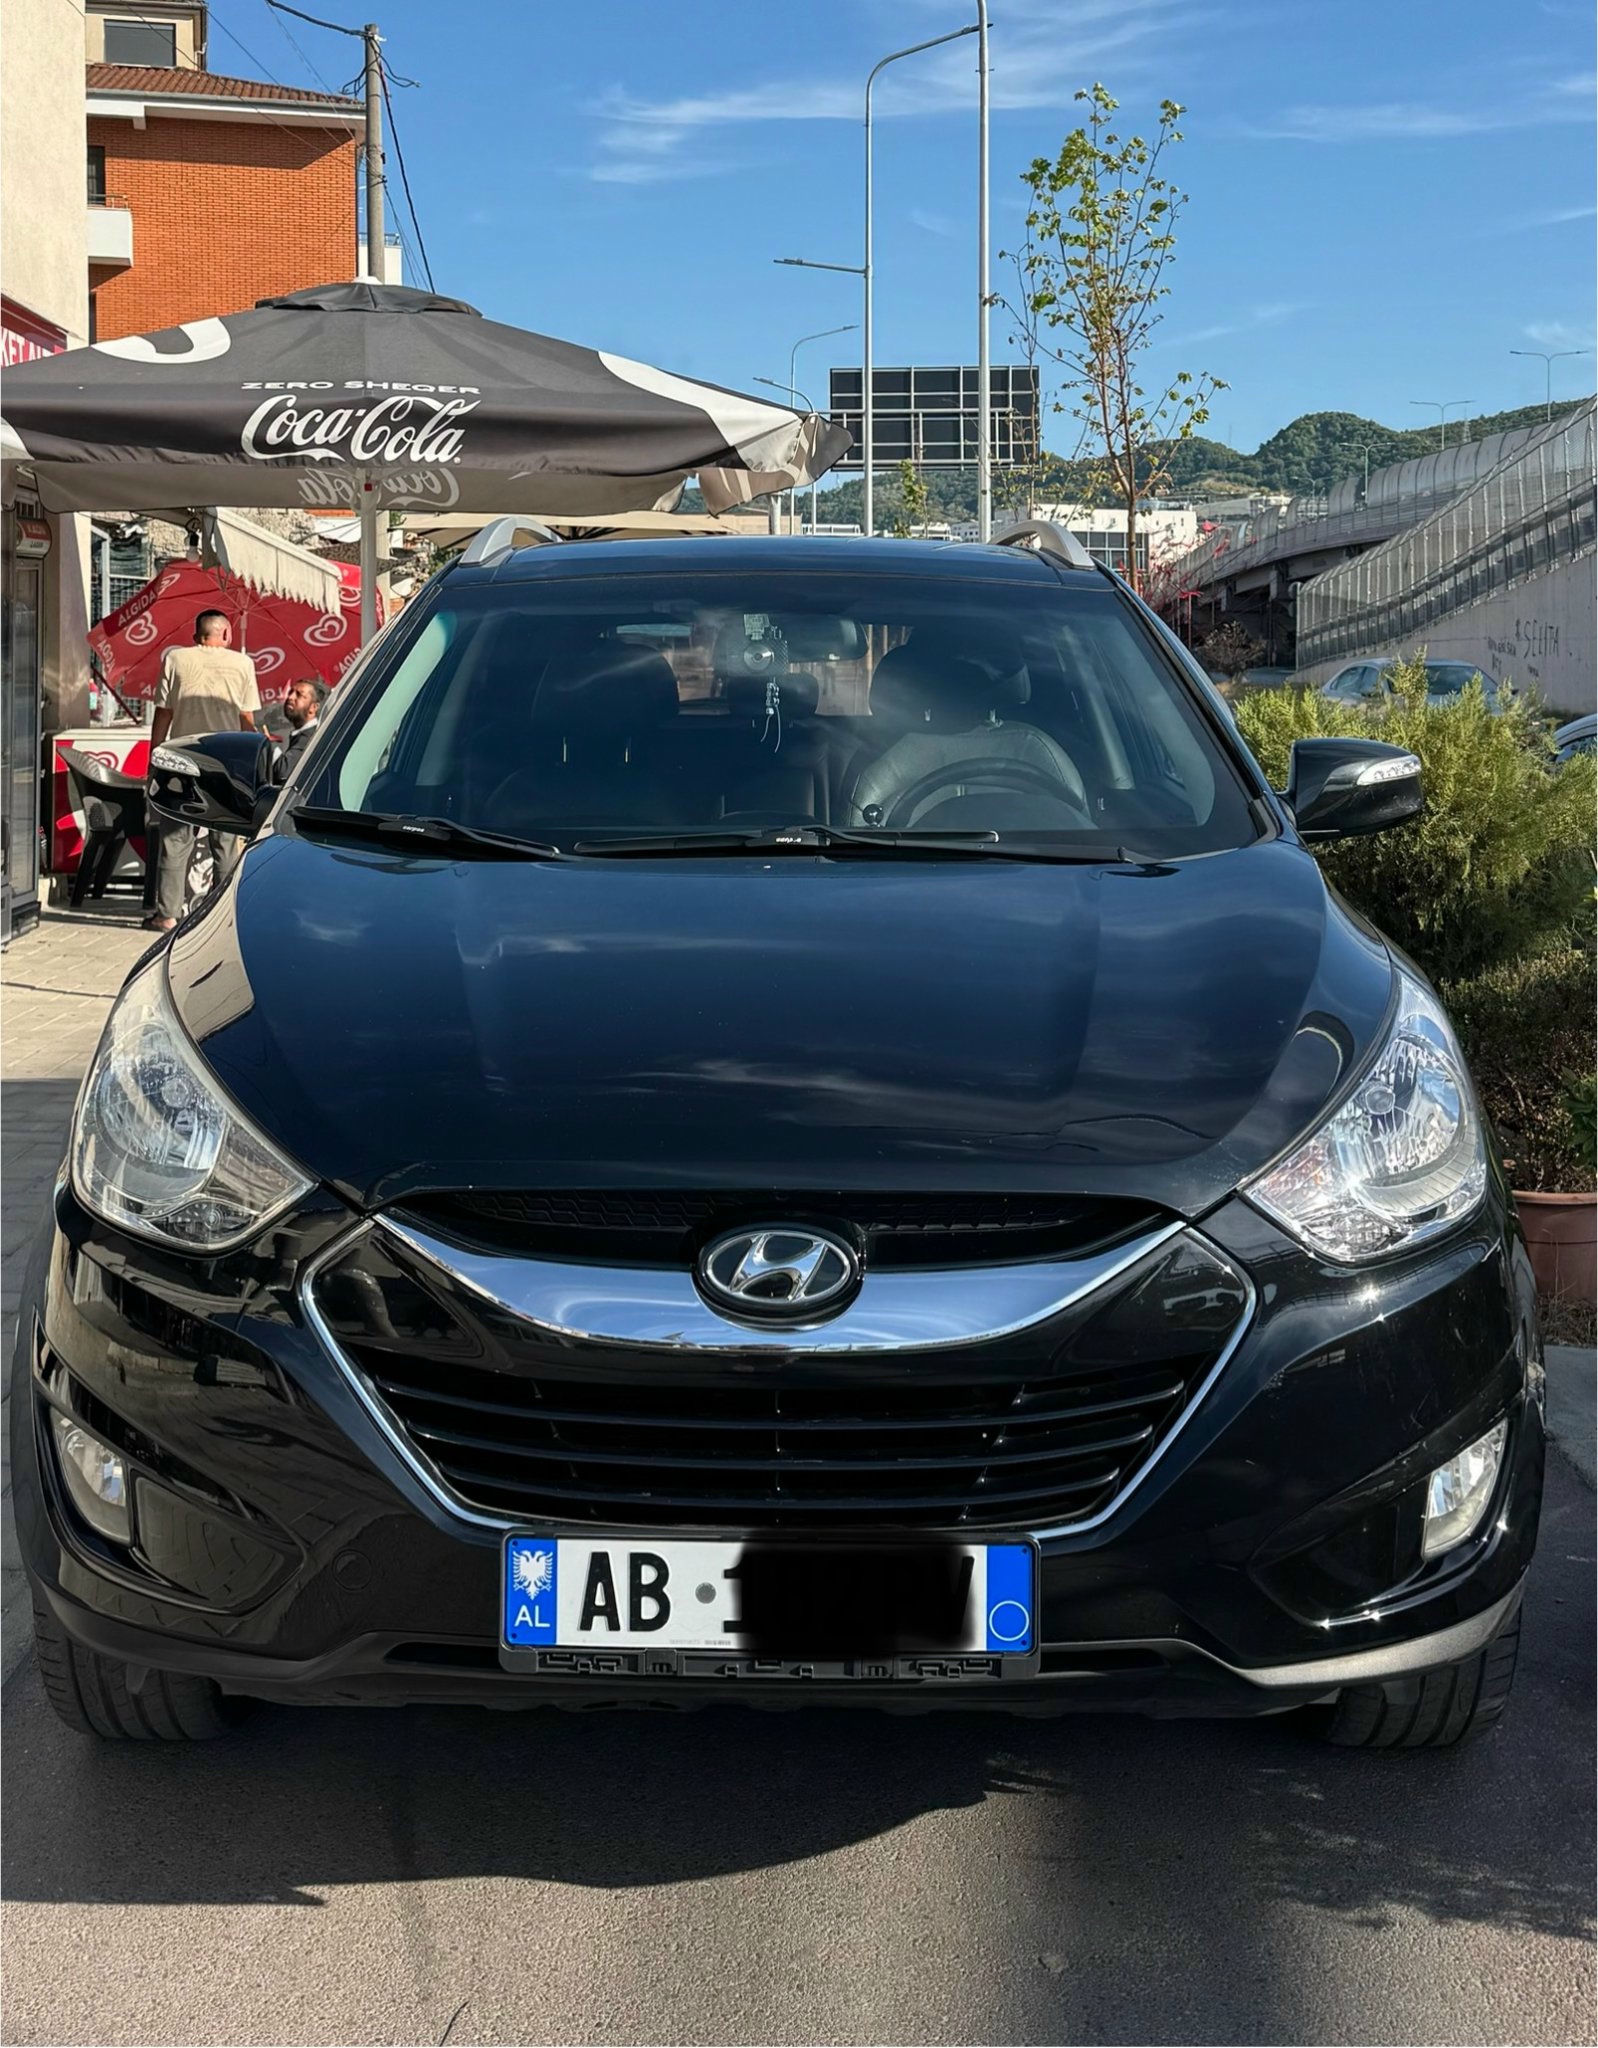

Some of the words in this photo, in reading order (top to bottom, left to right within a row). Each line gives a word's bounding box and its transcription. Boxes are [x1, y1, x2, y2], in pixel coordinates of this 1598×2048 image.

[241, 381, 334, 391] ZERO
[344, 380, 481, 395] SHEQER
[241, 394, 482, 464] Coca-Cola
[118, 590, 157, 626] ALGIDA
[579, 1551, 671, 1632] AB
[514, 1604, 550, 1628] AL
